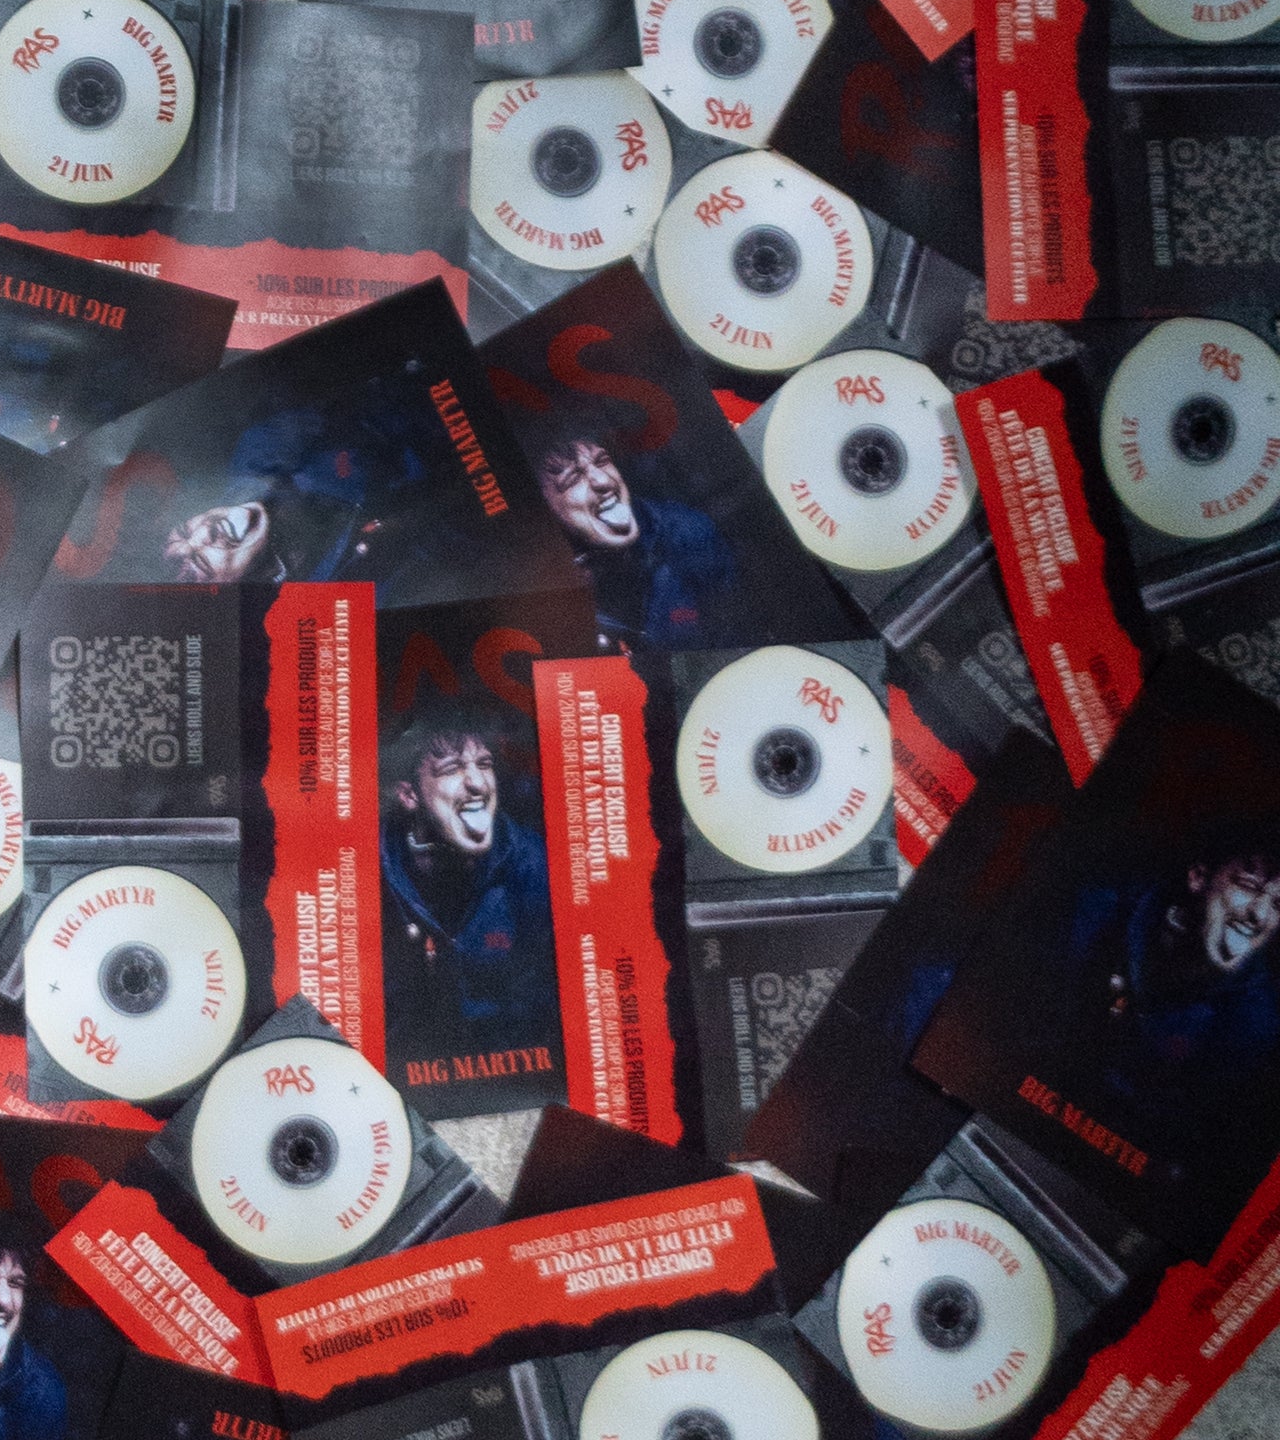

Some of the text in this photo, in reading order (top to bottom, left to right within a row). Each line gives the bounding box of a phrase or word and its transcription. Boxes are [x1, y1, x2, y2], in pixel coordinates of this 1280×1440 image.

[10, 26, 61, 74] RAS
[121, 16, 179, 126] BIG MARTYR
[47, 155, 117, 186] 21 JUIN
[693, 185, 747, 228] RAS
[810, 195, 856, 310] BIG MARTYR
[81, 296, 126, 329] BIG
[708, 314, 775, 352] 21 JUIN
[298, 616, 316, 756] SUR LES PRODUITS
[334, 598, 350, 818] SUR PRÉSENTATION DE CE FLYER
[577, 689, 609, 884] FÊTE DE LA MUSIQUE
[600, 712, 629, 860] CONCERT EXCLUSIF
[262, 1063, 317, 1098] RAS
[406, 1046, 553, 1085] BIG MARTYR
[336, 1120, 392, 1233] BIG MARTYR
[218, 1177, 268, 1234] 21 JUIN
